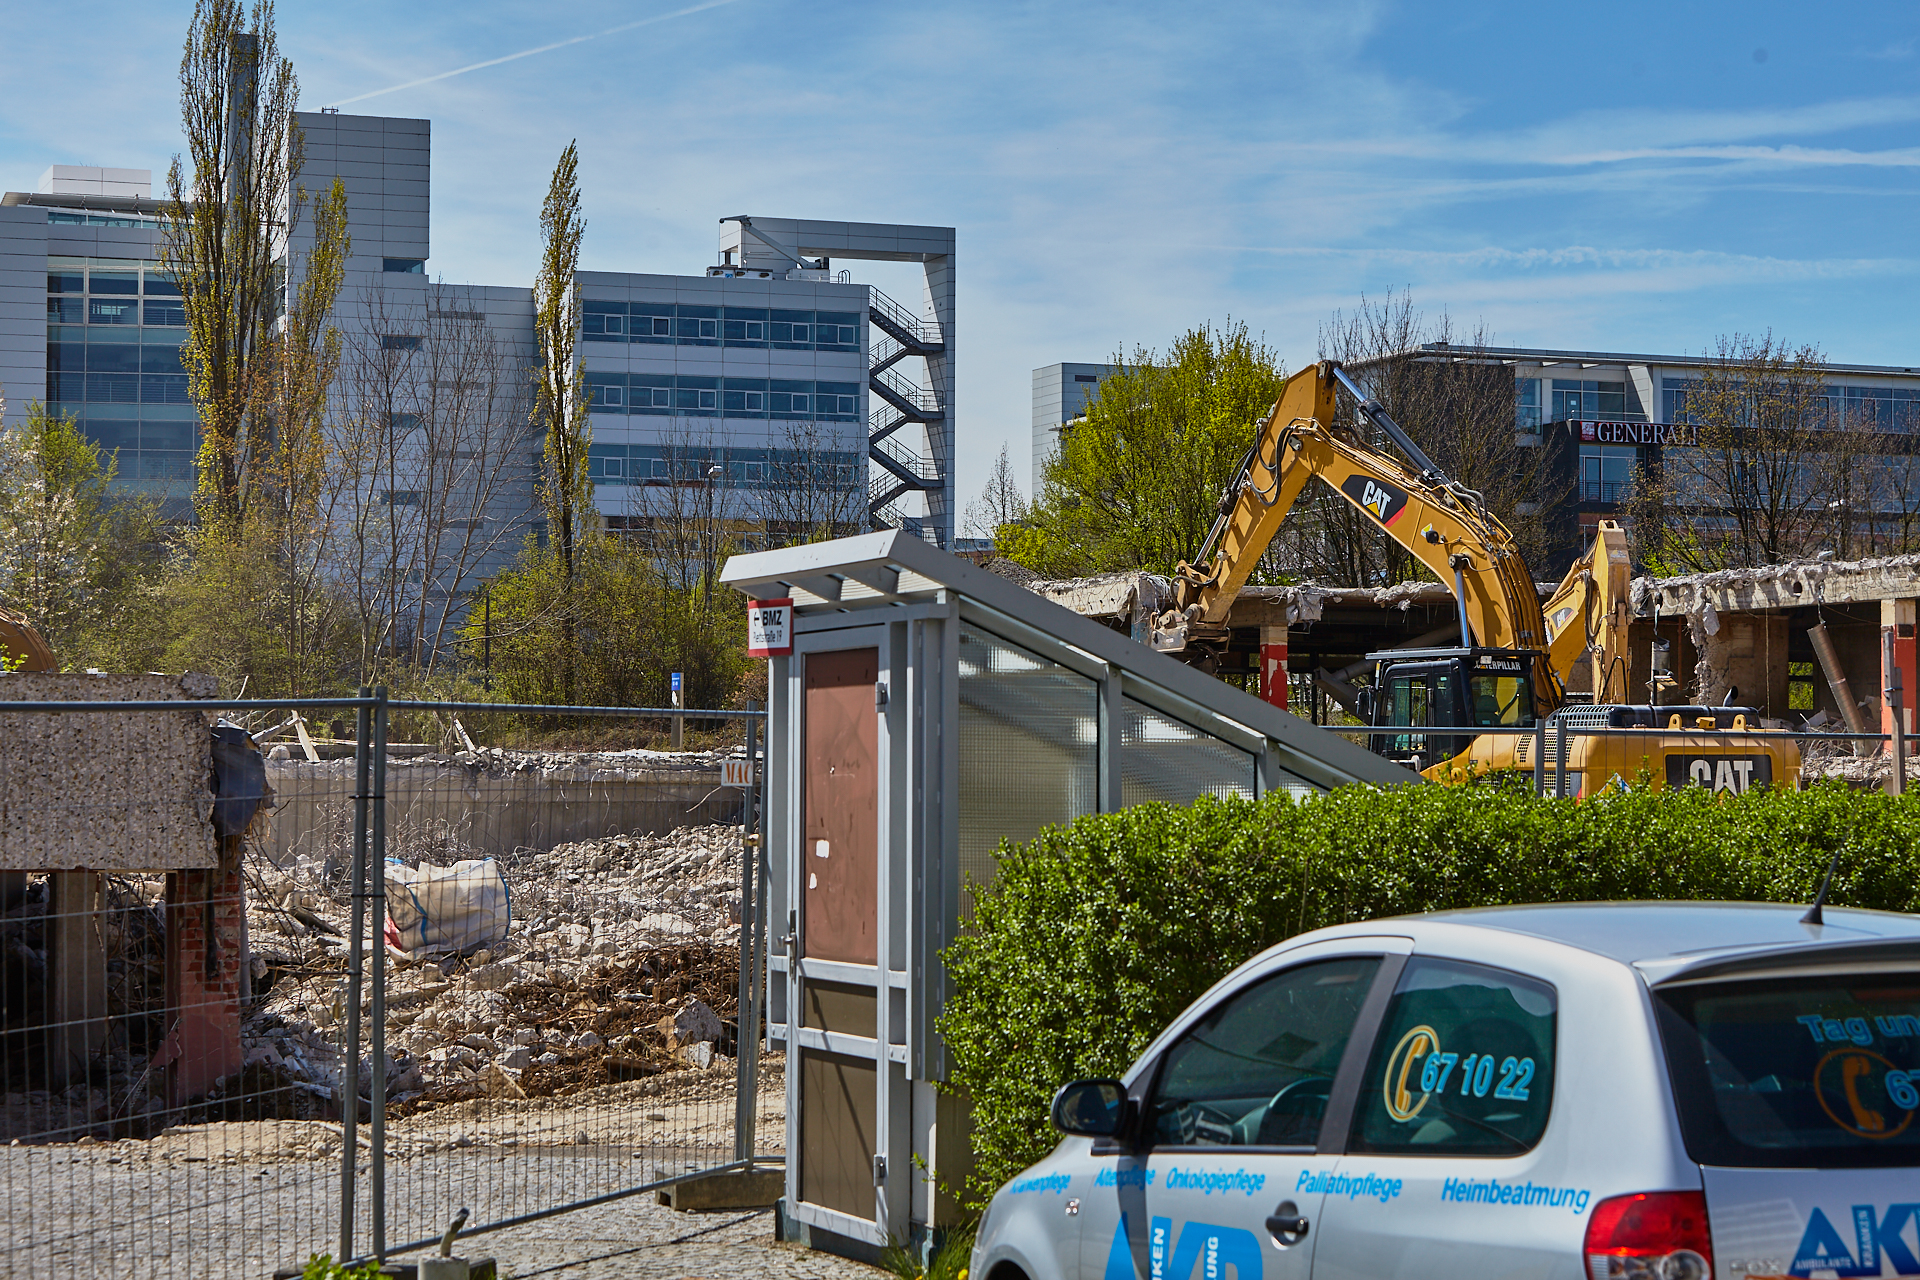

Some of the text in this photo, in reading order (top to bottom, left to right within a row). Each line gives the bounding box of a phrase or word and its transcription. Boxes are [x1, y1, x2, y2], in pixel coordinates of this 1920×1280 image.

[1597, 422, 1699, 446] GENERALI
[1362, 480, 1392, 520] CAT
[762, 609, 783, 626] BMZ
[1473, 660, 1522, 671] CTERPILLAR
[724, 762, 753, 784] MAC
[1689, 759, 1753, 798] CAT
[1796, 1014, 1920, 1046] Tag un
[1420, 1051, 1536, 1101] 67 10 22
[1166, 1167, 1265, 1196] Onkologiepflege
[1295, 1169, 1402, 1203] Palliativpflege
[1441, 1177, 1590, 1214] Heimbeatmung
[1206, 1236, 1219, 1280] UNG
[1787, 1203, 1920, 1279] AK
